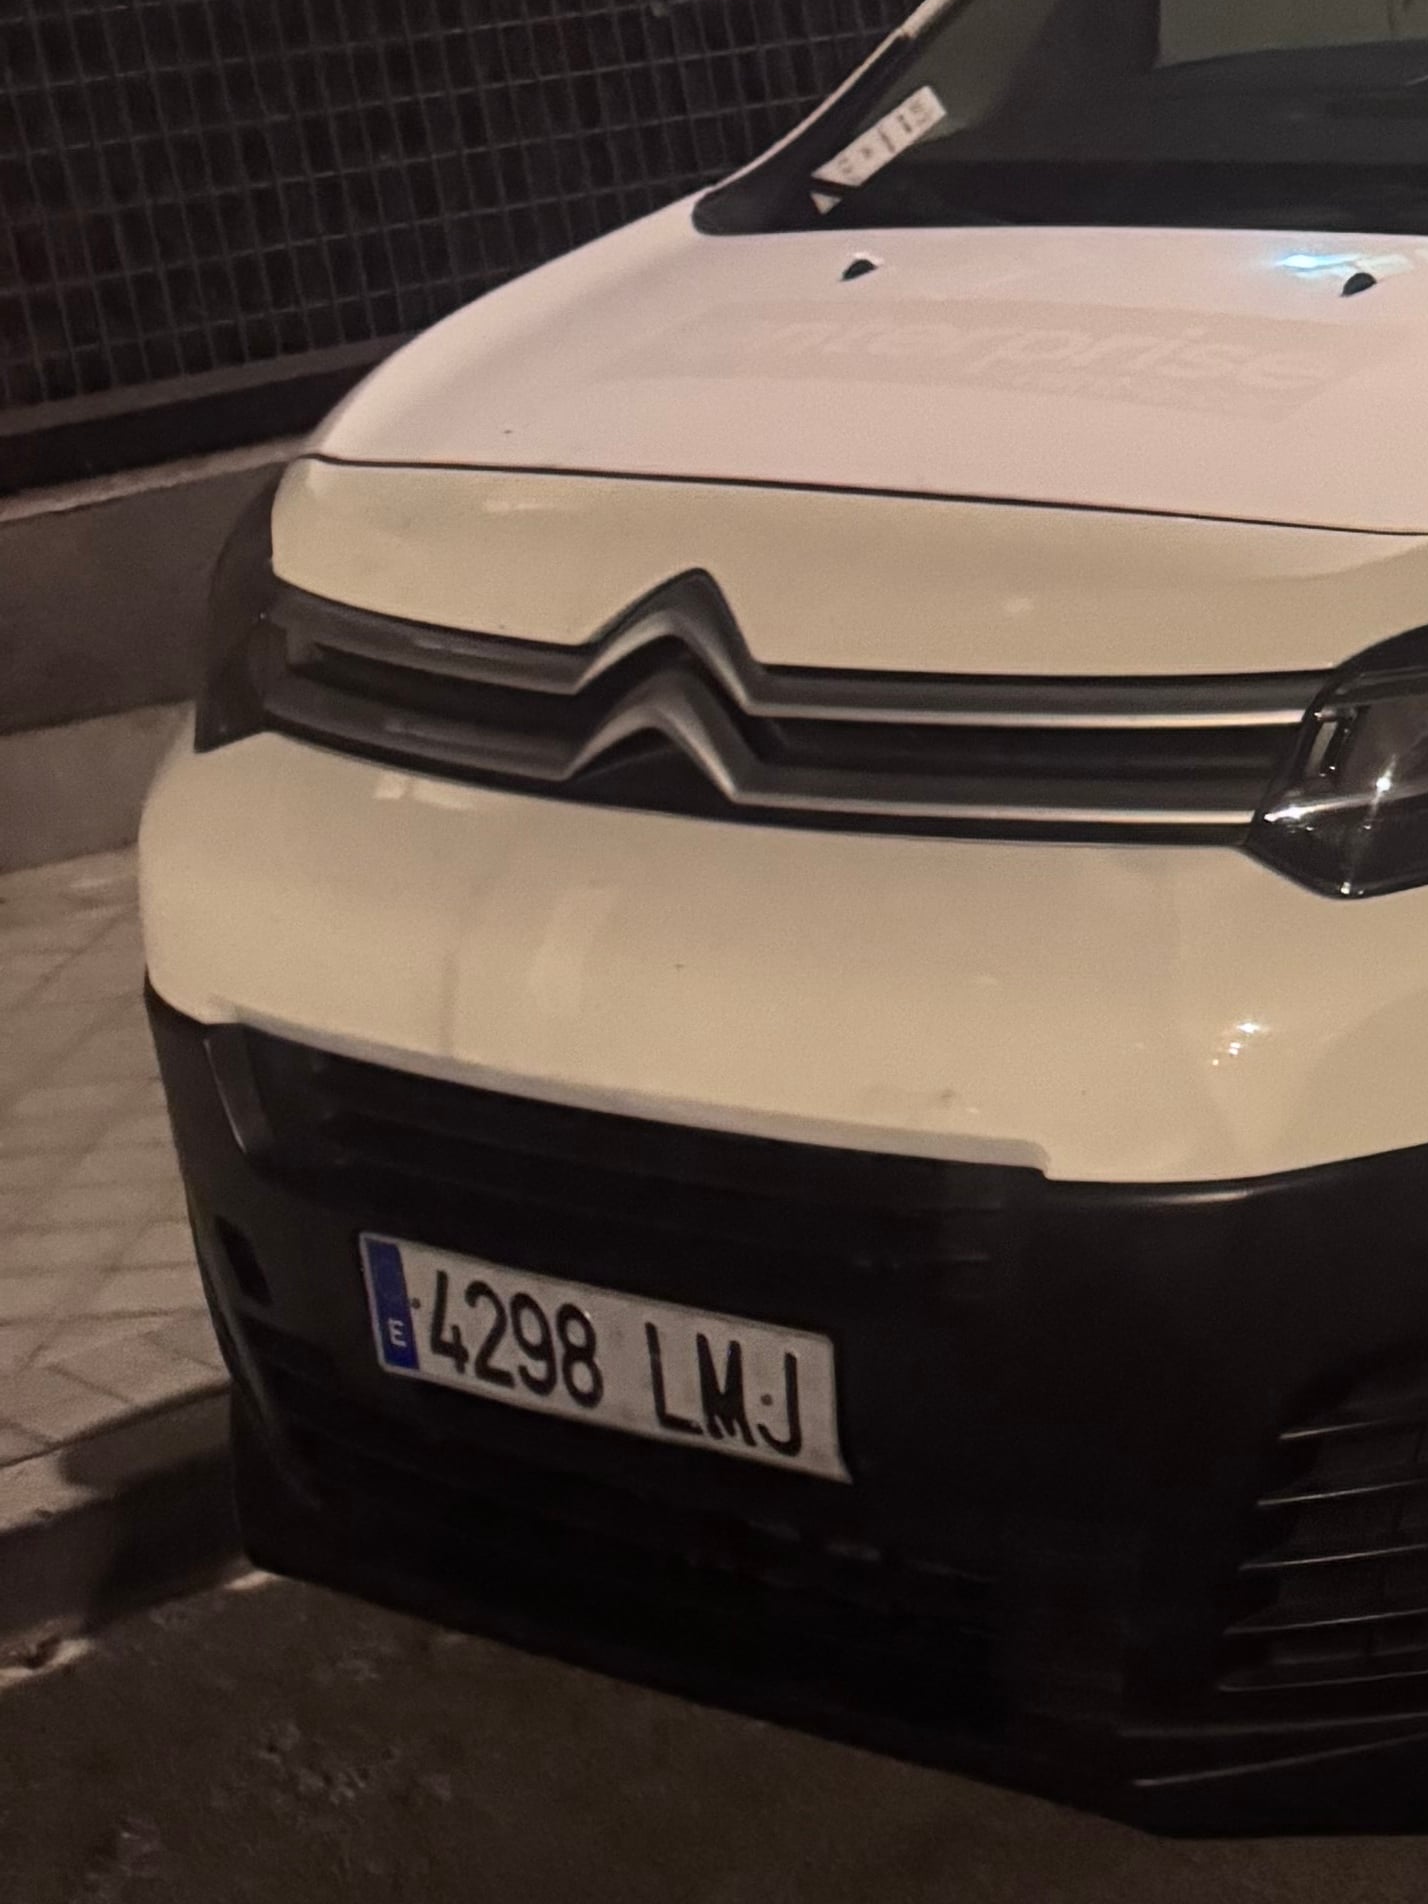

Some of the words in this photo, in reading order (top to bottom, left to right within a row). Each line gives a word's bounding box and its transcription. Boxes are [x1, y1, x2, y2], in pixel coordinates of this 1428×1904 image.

[388, 1320, 405, 1348] E
[428, 1269, 604, 1409] 4298
[644, 1321, 802, 1457] LMJ
